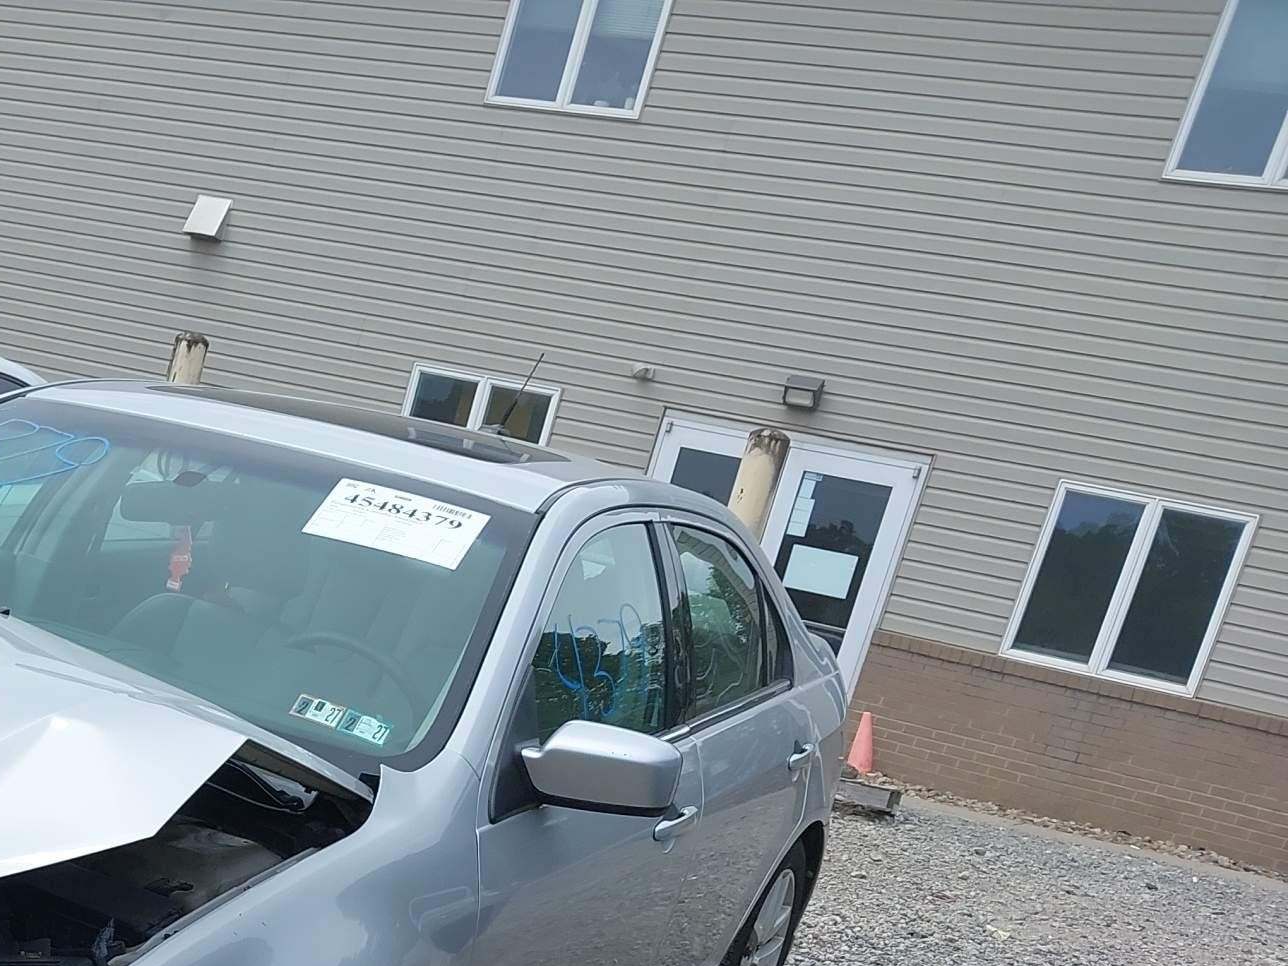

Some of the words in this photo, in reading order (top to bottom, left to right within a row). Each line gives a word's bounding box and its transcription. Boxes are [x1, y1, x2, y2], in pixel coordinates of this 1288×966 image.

[344, 492, 463, 530] 45484379
[324, 708, 342, 723] 27
[372, 724, 389, 742] 27
